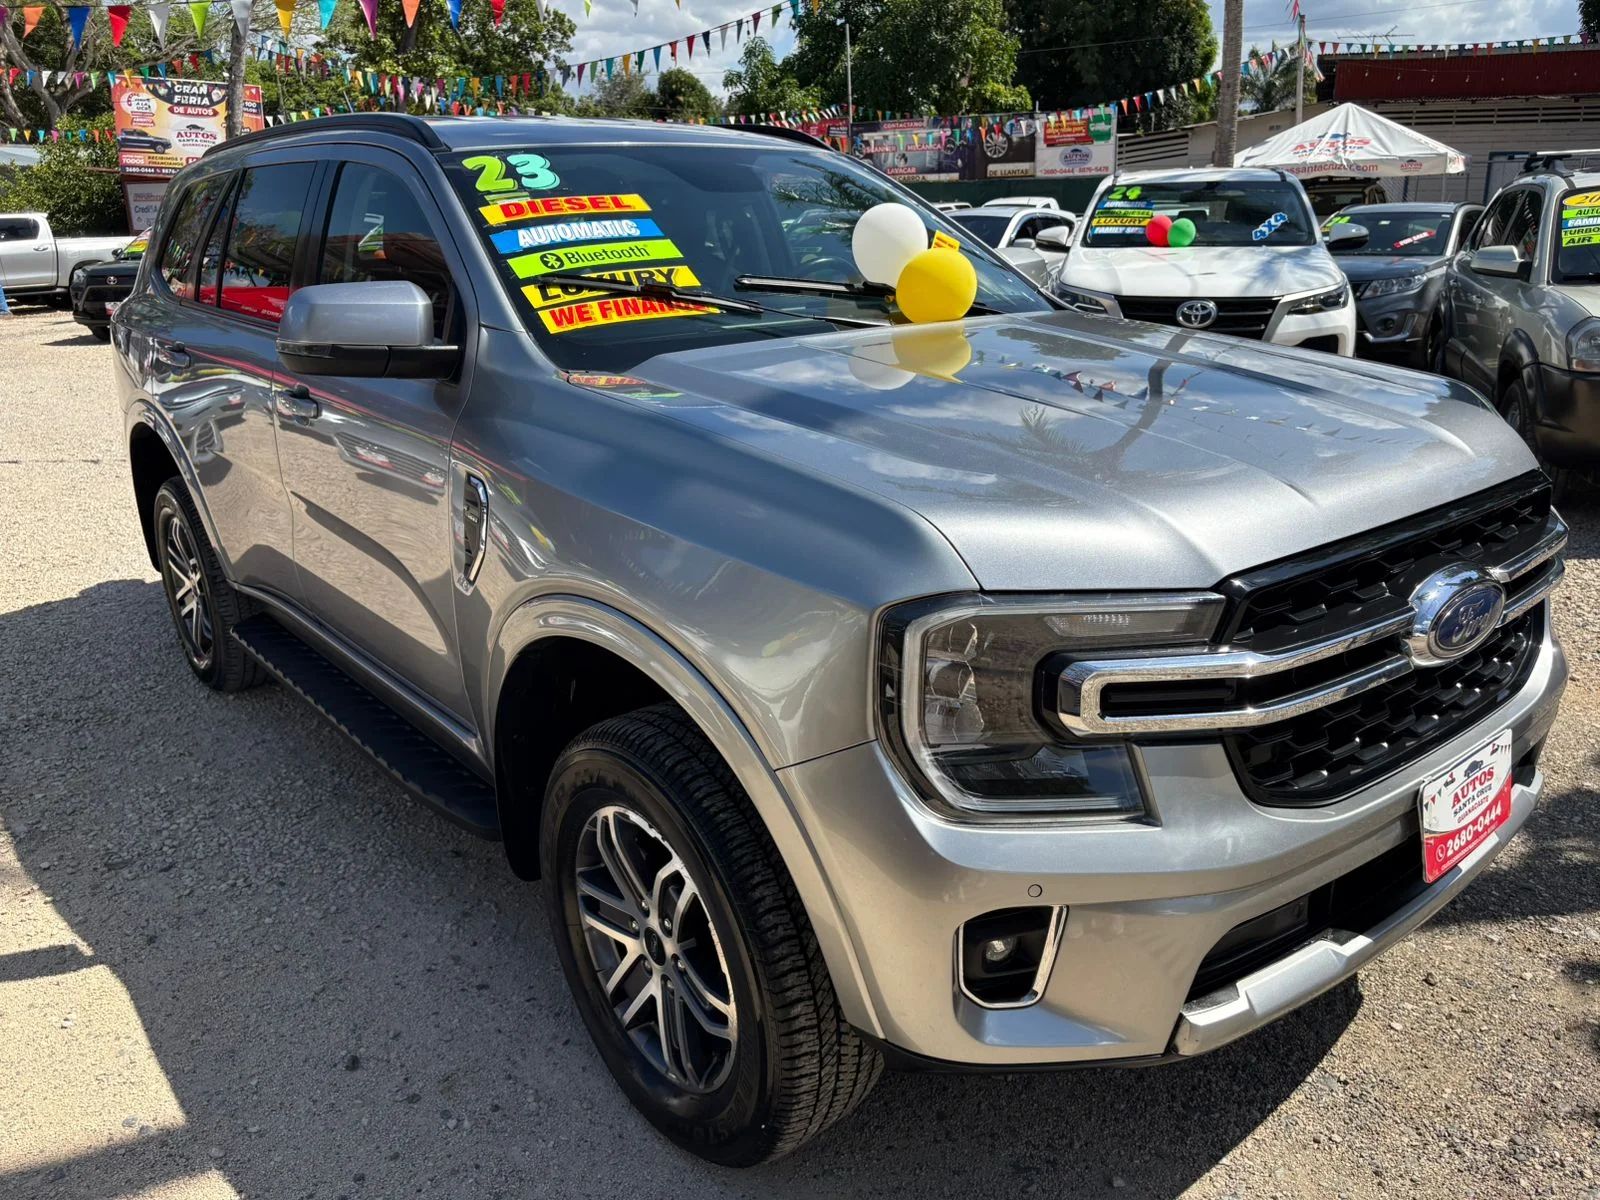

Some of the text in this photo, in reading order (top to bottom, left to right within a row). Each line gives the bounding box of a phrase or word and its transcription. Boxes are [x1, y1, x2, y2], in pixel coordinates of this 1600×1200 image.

[174, 84, 208, 95] GRAN
[174, 95, 210, 106] FERIA
[187, 107, 214, 116] AUTOS
[176, 131, 218, 140] AUTOS
[461, 153, 560, 192] 23
[1108, 186, 1143, 200] 24
[500, 196, 634, 218] DIESEL
[517, 219, 641, 249] AUTOMATIC
[1565, 237, 1593, 246] AIR
[565, 246, 650, 266] Bluetooth
[549, 303, 595, 328] WE
[1451, 599, 1494, 643] Ford
[1451, 766, 1495, 809] AUTOS
[1453, 783, 1493, 818] SANTA CRUZ
[1457, 795, 1490, 824] GUANACASTE
[1446, 799, 1502, 857] 2680-0444
